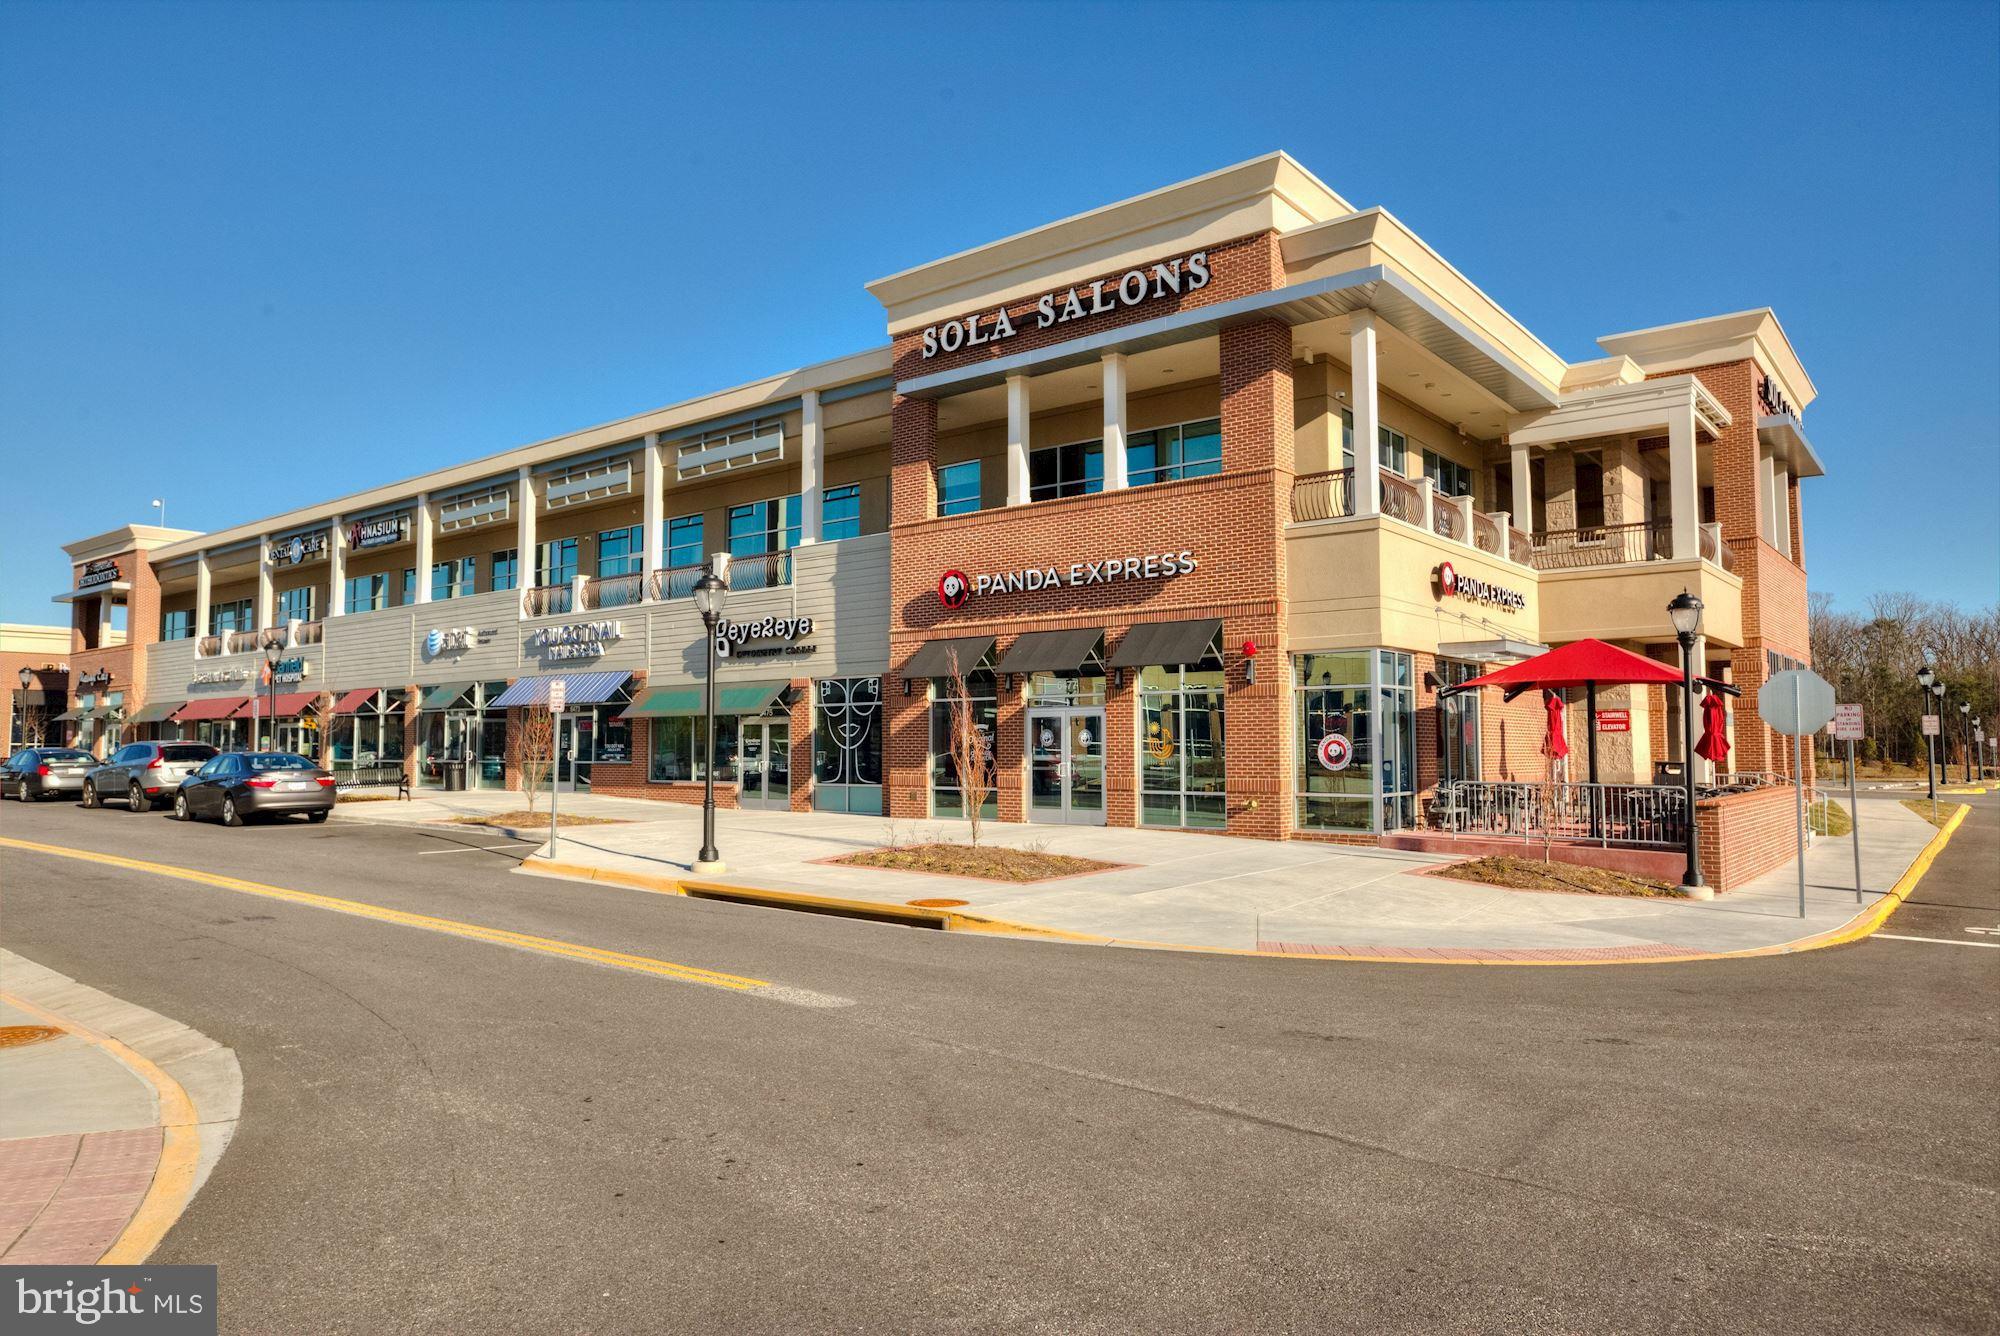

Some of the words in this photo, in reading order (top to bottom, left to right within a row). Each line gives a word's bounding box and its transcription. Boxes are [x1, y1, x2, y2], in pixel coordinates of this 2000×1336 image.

[922, 307, 1017, 359] SOLA
[1037, 251, 1211, 329] SALONS
[346, 520, 398, 542] MATHNASIUM
[302, 538, 321, 554] CARE
[977, 566, 1062, 597] PANDA
[1070, 551, 1197, 587] EXPRESS
[1457, 574, 1490, 600] PANDA
[1490, 585, 1525, 609] EXPRESS
[534, 627, 561, 646] YOU
[589, 619, 624, 641] NAIL
[728, 616, 810, 645] eye2eye
[277, 657, 304, 674] anfield
[1601, 711, 1628, 719] STAIRWELL
